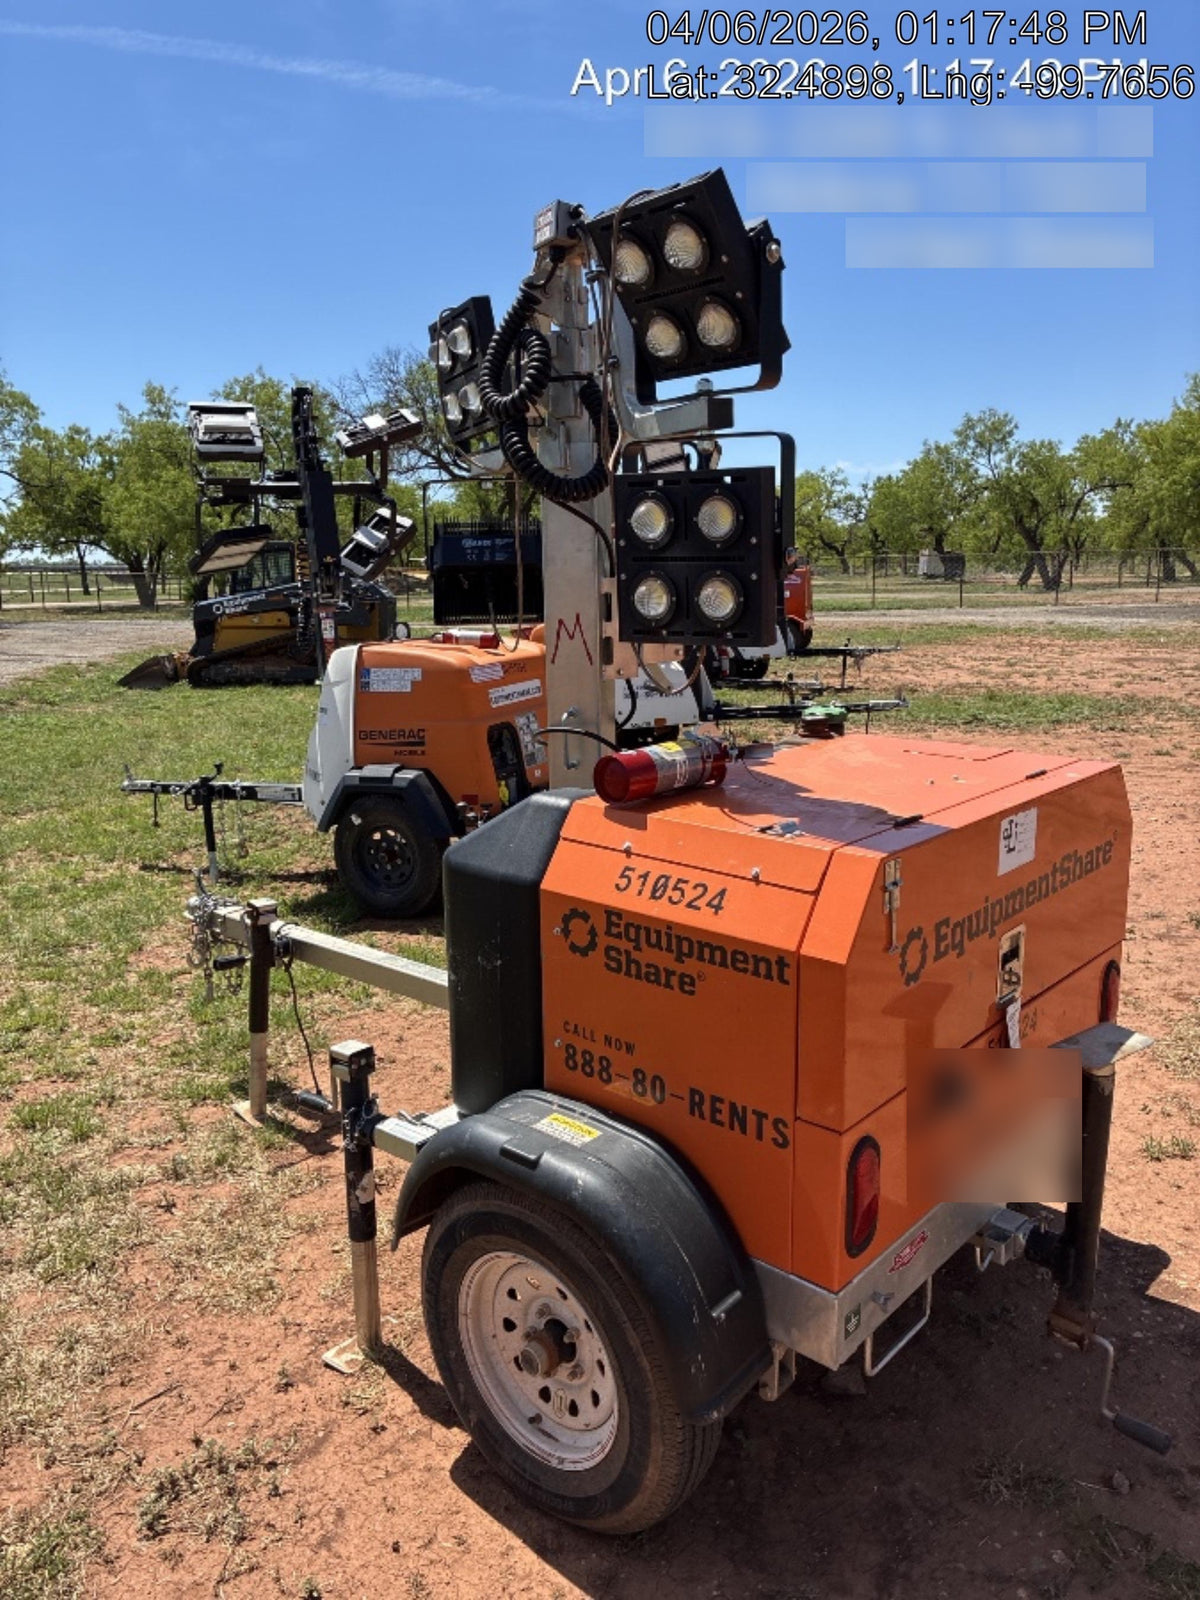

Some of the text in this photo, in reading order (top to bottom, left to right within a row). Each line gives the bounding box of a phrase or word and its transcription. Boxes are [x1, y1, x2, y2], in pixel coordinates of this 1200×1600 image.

[551, 613, 593, 666] M
[358, 728, 425, 741] GENERAC
[614, 865, 728, 916] 510524
[933, 838, 1115, 963] EquipmentShare
[604, 909, 791, 986] Equipment
[563, 1020, 636, 1057] CALL NOW
[564, 1043, 791, 1150] 888-80-RENTS
